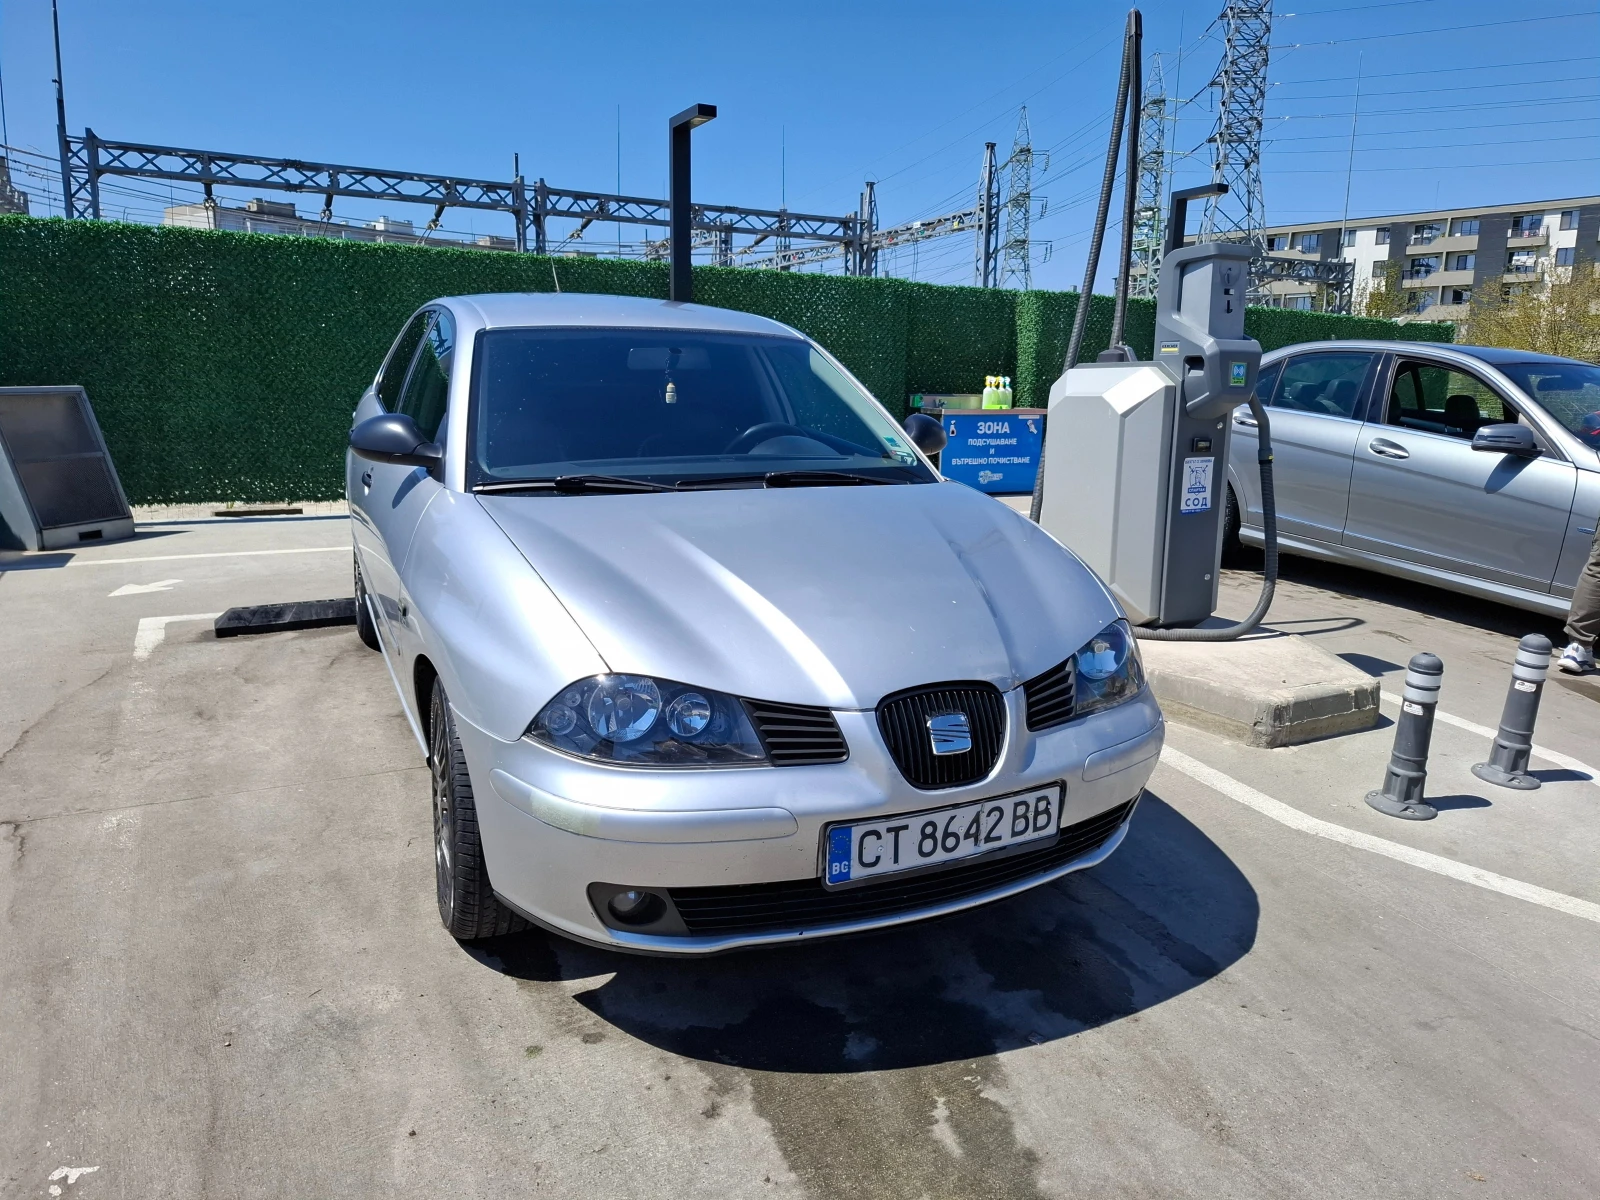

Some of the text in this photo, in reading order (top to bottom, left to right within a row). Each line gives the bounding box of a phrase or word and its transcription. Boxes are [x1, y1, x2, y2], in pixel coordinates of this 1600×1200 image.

[977, 421, 1010, 434] ЗОНА
[968, 438, 1017, 446] ПОДСУШАВАНЕ
[951, 456, 1030, 465] ВЪТРЕШНО ПОЧИСТВАНЕ
[1185, 497, 1208, 507] СОД
[857, 795, 1052, 868] CT 8642 BB
[831, 861, 849, 876] BG
